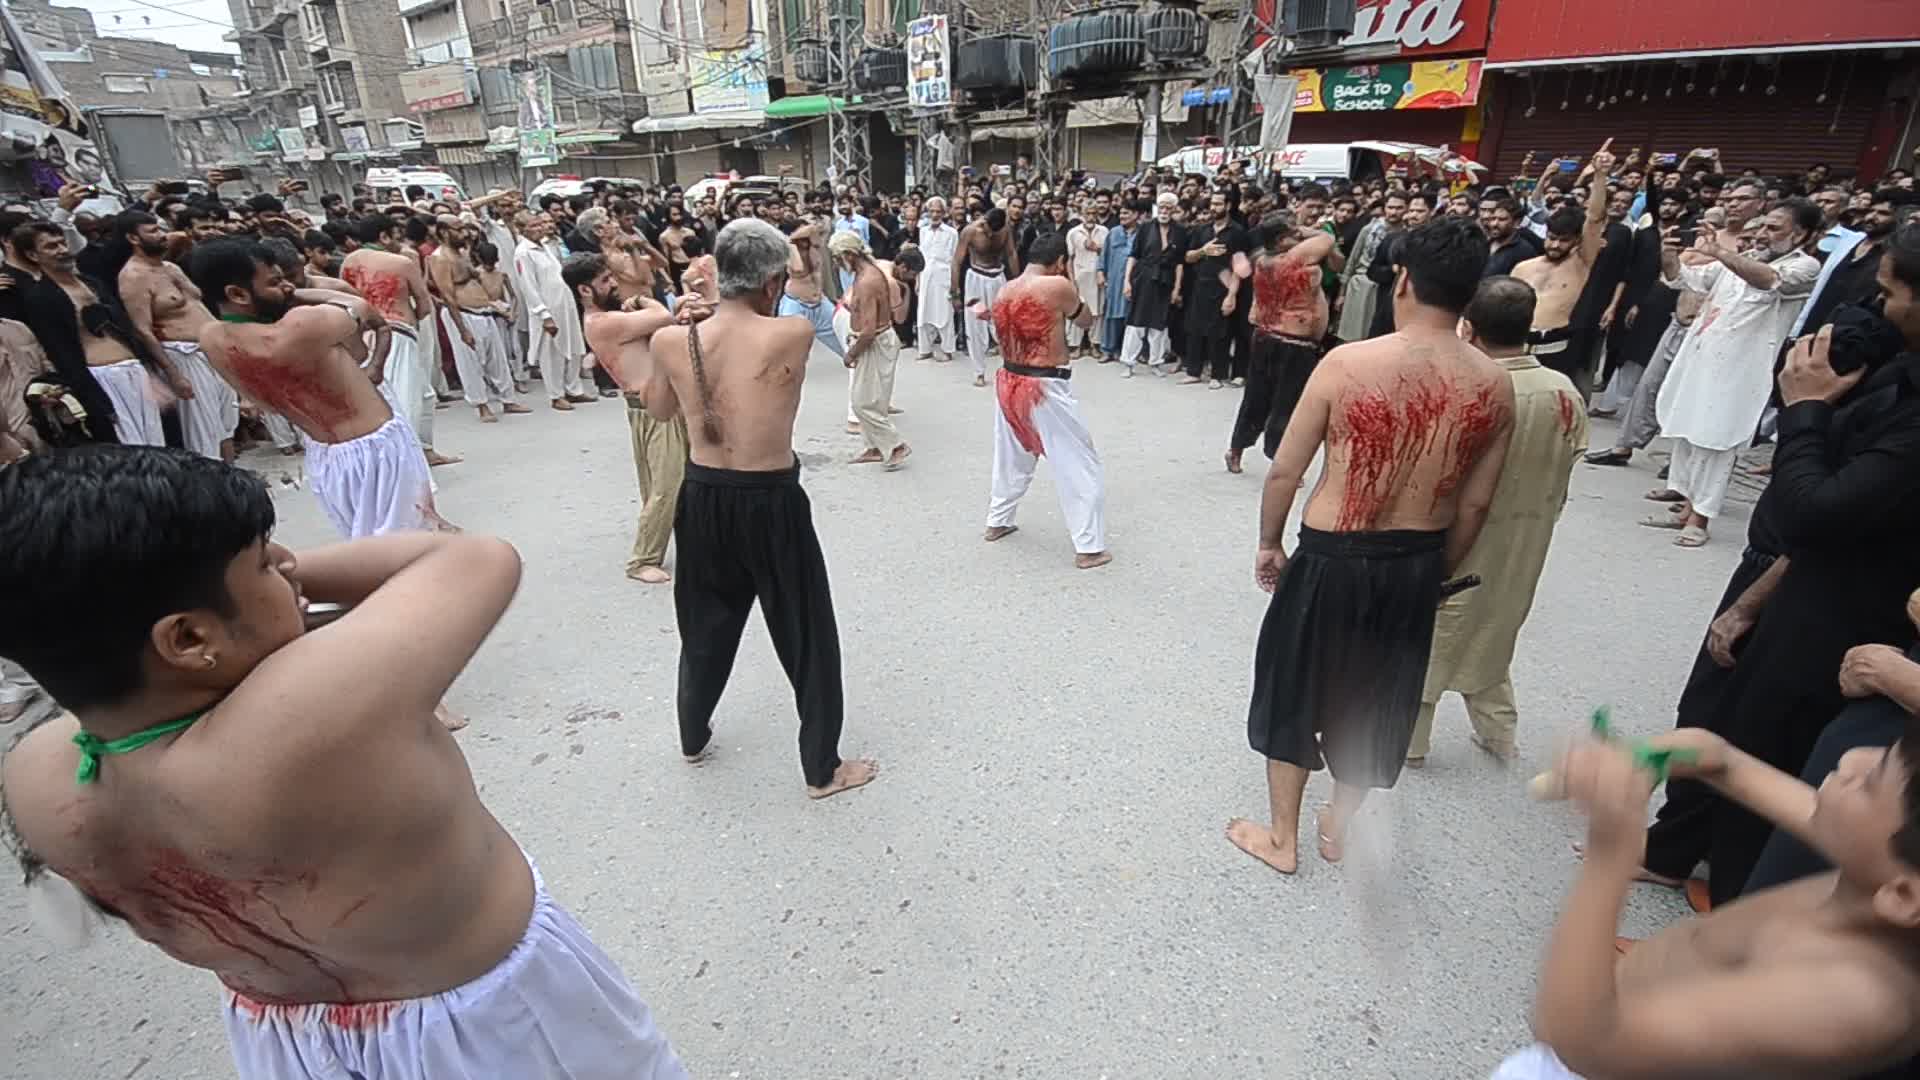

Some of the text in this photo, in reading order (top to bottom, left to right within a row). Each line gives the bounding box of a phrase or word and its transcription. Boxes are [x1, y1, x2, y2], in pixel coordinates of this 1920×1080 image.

[1333, 82, 1393, 99] BACK TO
[1333, 98, 1388, 111] SCHOOL
